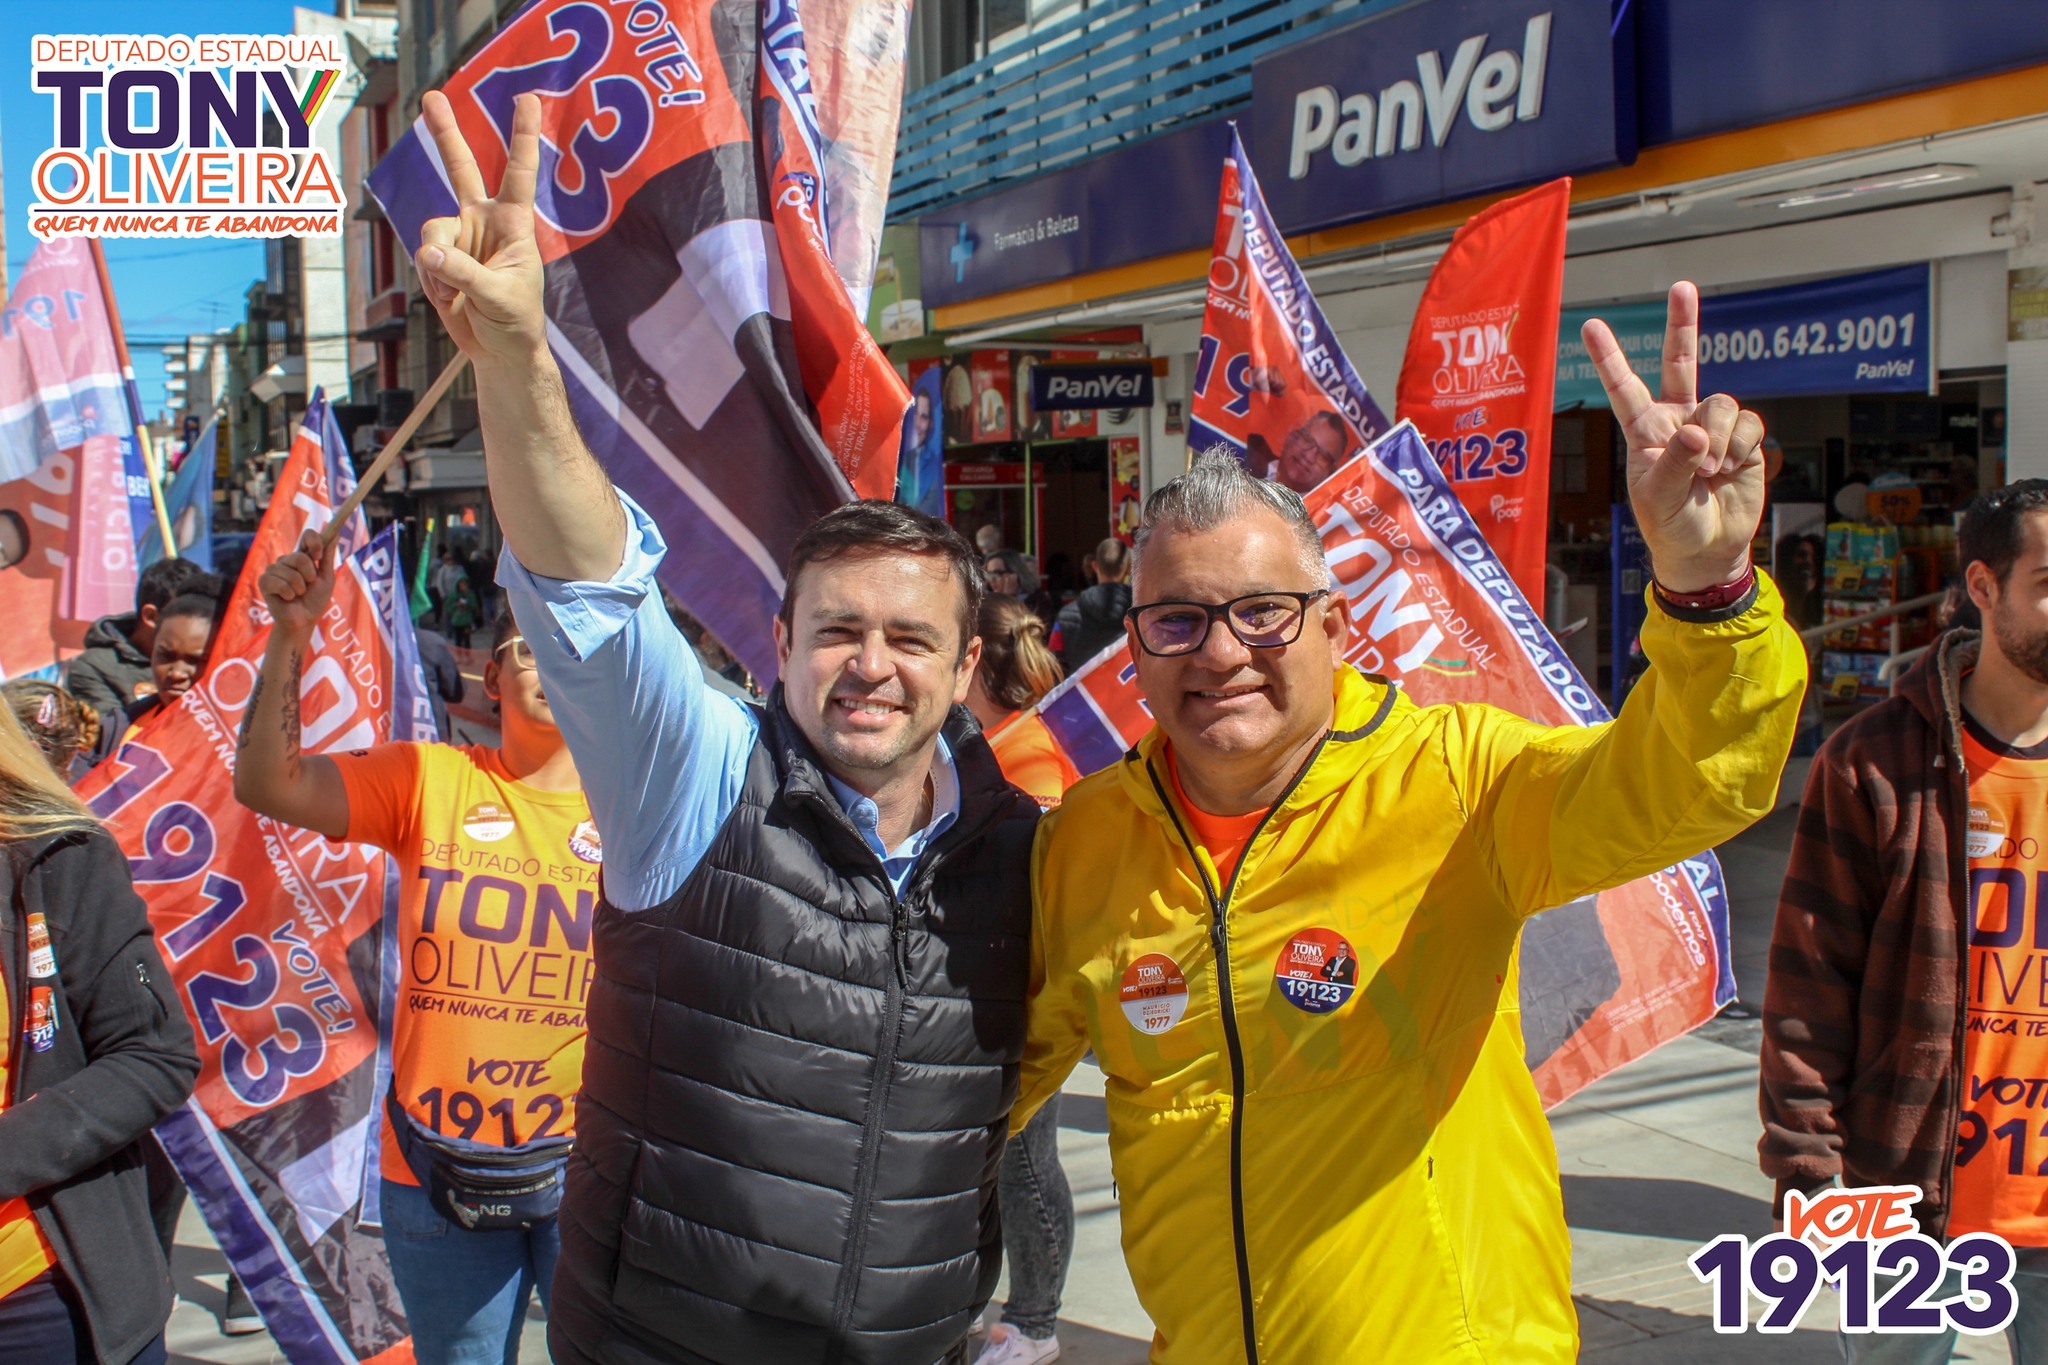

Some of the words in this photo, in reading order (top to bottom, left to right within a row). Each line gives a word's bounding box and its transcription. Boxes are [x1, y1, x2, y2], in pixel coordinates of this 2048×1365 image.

[610, 0, 706, 108] OTE!
[1289, 11, 1553, 180] PanVel
[1047, 214, 1079, 238] Beleza
[1242, 209, 1317, 343] DEPUTADO
[1304, 343, 1376, 440] ESTADU
[1698, 313, 1914, 364] 0800.642.9001
[1047, 374, 1142, 399] PanVel
[1856, 359, 1914, 379] PanVel
[1317, 502, 1445, 674] TONY
[1341, 485, 1421, 567] DEPUTADO
[1415, 573, 1497, 670] ESTADUAL
[1398, 467, 1463, 542] PARA
[1453, 537, 1593, 712] DEPUTADO
[322, 598, 383, 708] PUTADO
[180, 689, 223, 743] QUEM
[419, 837, 541, 878] DEPUTADO
[548, 864, 599, 884] ESTA
[1967, 844, 1988, 854] 977
[263, 834, 329, 938] ABANDONA
[418, 864, 594, 952] TON
[84, 741, 327, 1107] 19123
[1649, 870, 1706, 967] podemos
[1137, 965, 1164, 977] TONY
[1290, 952, 1325, 964] OLIVEIRA
[1292, 942, 1327, 957] TONY
[271, 919, 355, 1034] VOTE!
[1122, 985, 1138, 993] VOTE!
[1138, 985, 1168, 998] 19123
[1138, 974, 1166, 984] OLIVEIRA
[1286, 979, 1342, 1003] 19123
[1289, 969, 1313, 980] VOTE!
[409, 995, 444, 1014] QUEM
[447, 999, 514, 1021] NUNCA
[515, 1007, 538, 1024] TE
[1144, 1015, 1171, 1030] 1977
[466, 1056, 553, 1089] VOTE
[417, 1086, 576, 1147] 1912
